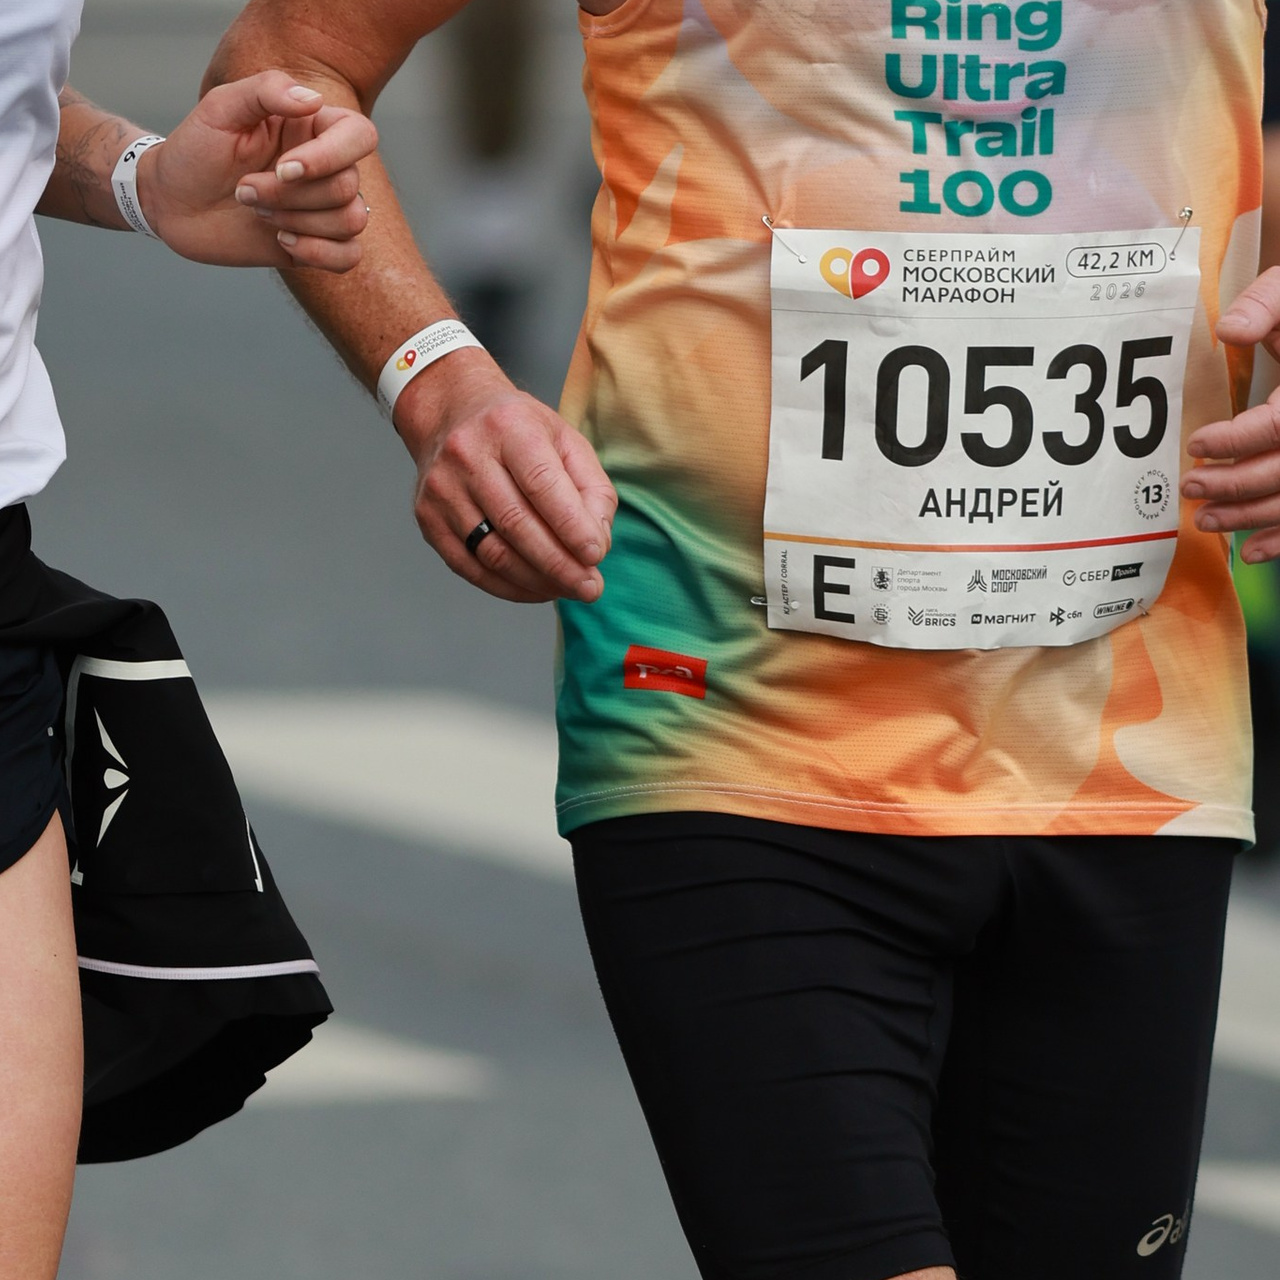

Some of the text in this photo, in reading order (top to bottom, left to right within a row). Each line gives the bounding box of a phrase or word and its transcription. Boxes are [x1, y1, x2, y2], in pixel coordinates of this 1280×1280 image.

[885, 53, 1067, 102] Ultra
[894, 106, 1054, 157] Trail
[899, 169, 1052, 217] 100
[903, 247, 1016, 262] СБЕРПРАЙМ
[1077, 249, 1154, 272] 42,2 КМ
[902, 264, 1056, 284] МОСКОВСКИЙ
[902, 287, 1015, 303] МАРАФОН
[1090, 281, 1147, 301] 2026
[800, 335, 1174, 468] 10535
[918, 480, 1064, 524] АНДРЕЙ
[1141, 484, 1163, 504] 13
[780, 549, 788, 579] CORRAL
[991, 565, 1048, 580] МОСКОВСКИЙ
[1079, 569, 1110, 582] СБЕР
[813, 554, 856, 624] E
[991, 581, 1018, 593] СПОРТ
[984, 613, 1036, 624] магнит
[1096, 602, 1126, 615] WINLINE
[925, 617, 956, 626] BRICS
